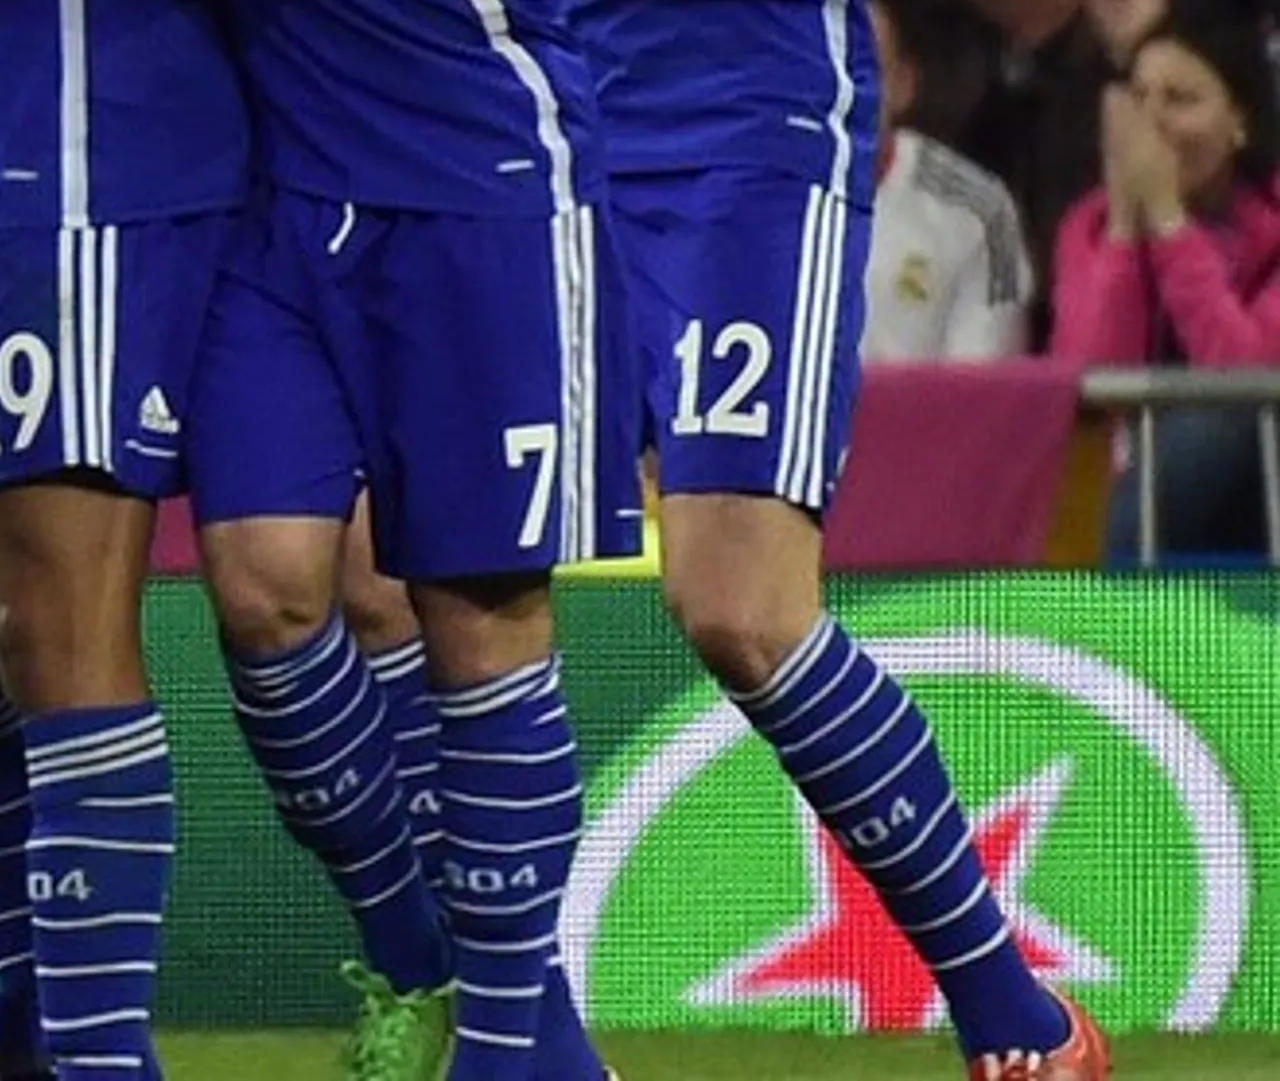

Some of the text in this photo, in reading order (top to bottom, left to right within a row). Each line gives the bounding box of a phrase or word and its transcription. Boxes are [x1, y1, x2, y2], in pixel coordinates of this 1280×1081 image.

[671, 319, 771, 437] 12
[504, 423, 557, 547] 7
[27, 869, 95, 903] 04
